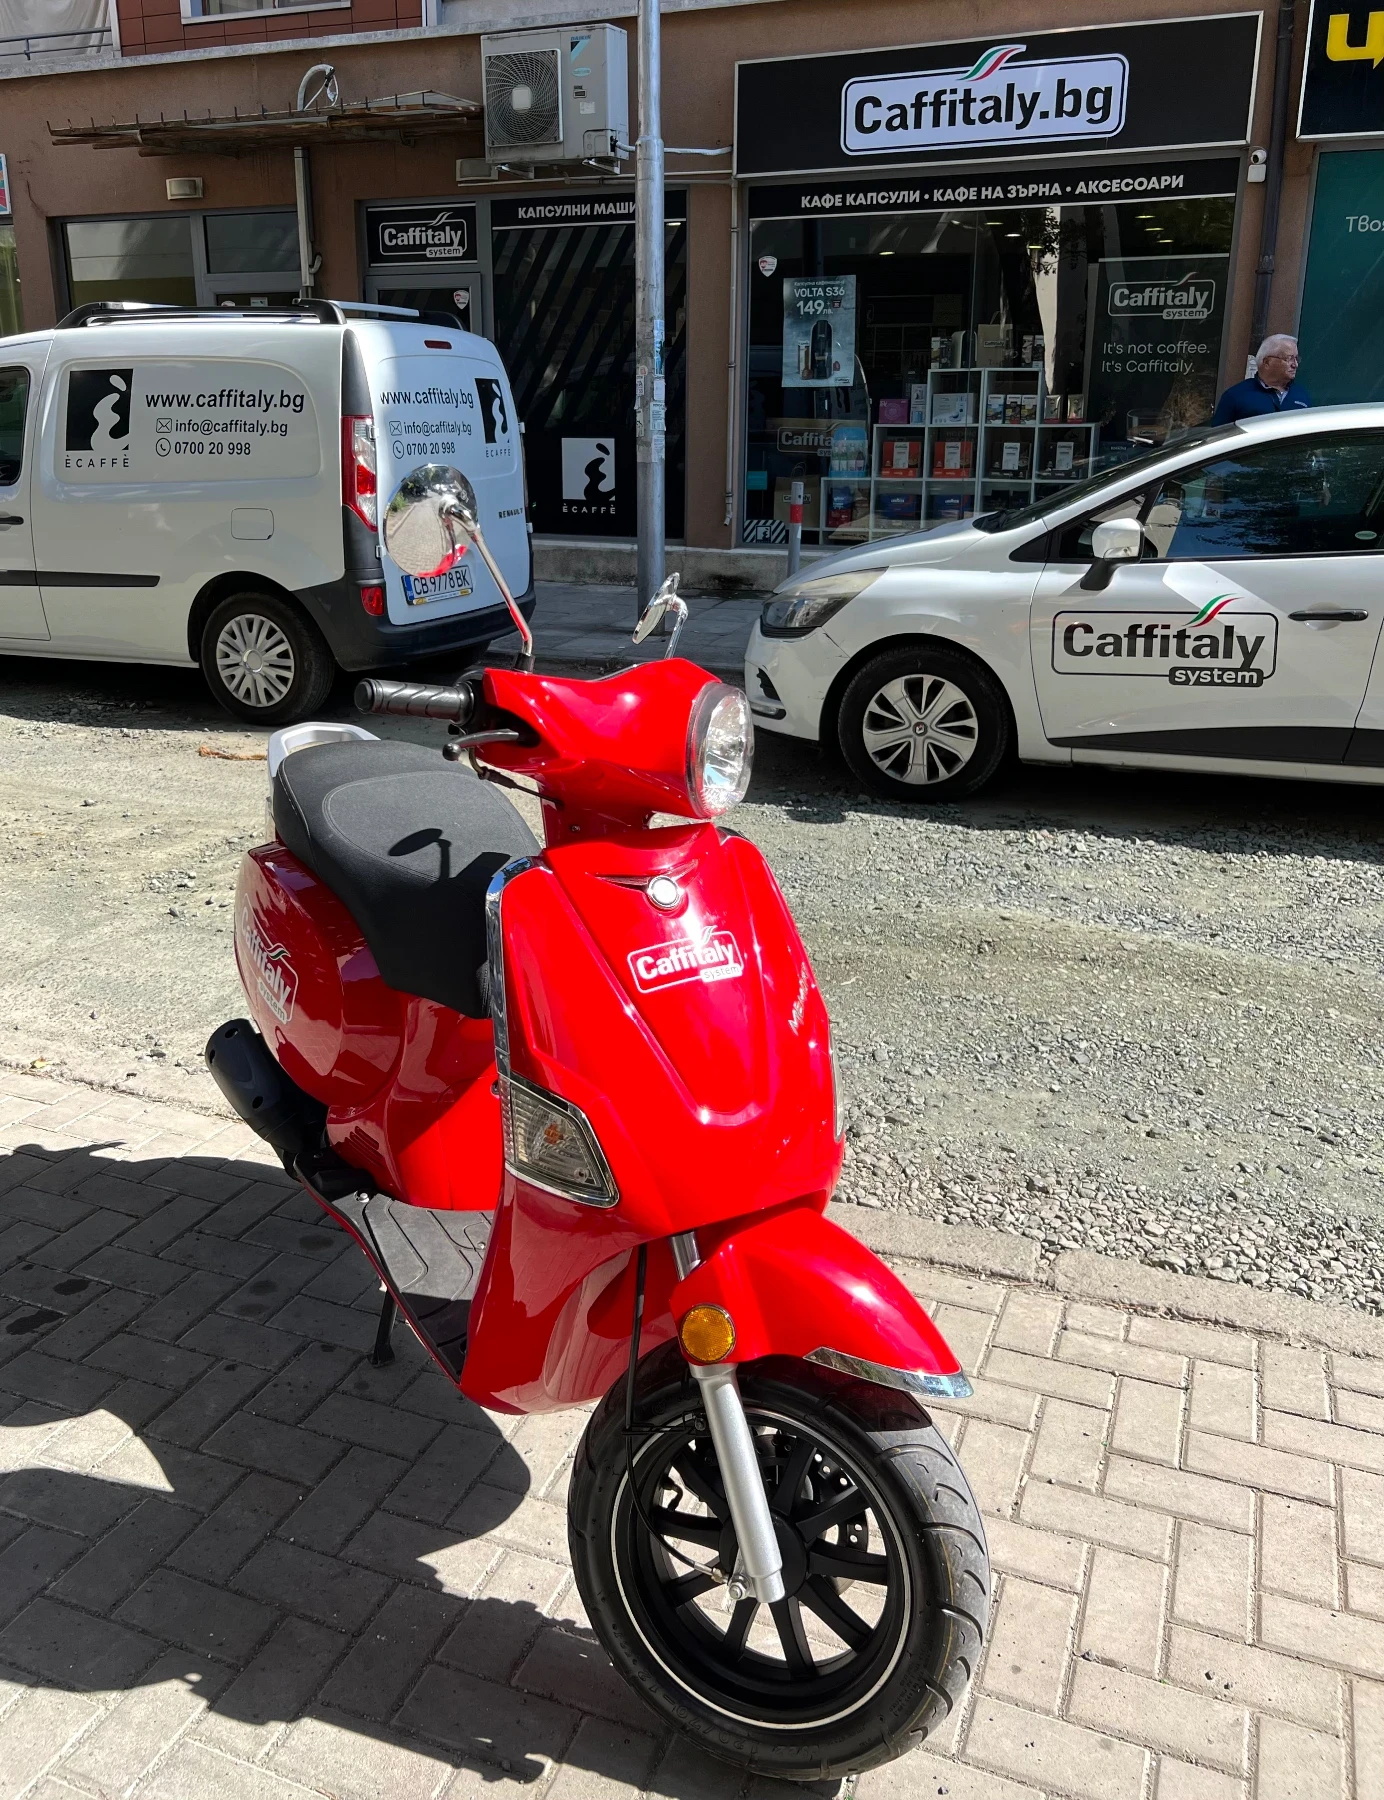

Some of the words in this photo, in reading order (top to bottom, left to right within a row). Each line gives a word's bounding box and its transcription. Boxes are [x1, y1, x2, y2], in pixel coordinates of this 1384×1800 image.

[854, 78, 1112, 134] Caffitaly.bg
[801, 194, 842, 209] КАФЕ
[845, 189, 920, 207] КАПСУЛИ
[933, 187, 978, 203] КАФЕ
[981, 184, 1004, 199] НА
[1007, 182, 1062, 198] ЗЪРНА
[1075, 174, 1185, 195] АКСЕСОАРИ
[518, 203, 591, 219] КАПСУЛНИ
[383, 226, 463, 248] Caffitaly
[428, 246, 461, 257] system
[794, 288, 824, 297] VOLTA
[825, 286, 845, 297] S36
[1113, 286, 1209, 311] Caffitaly
[796, 300, 824, 315] 149
[1165, 309, 1205, 318] system
[1103, 342, 1123, 354] It's
[1127, 342, 1153, 354] not
[1156, 340, 1210, 354] coffee.
[1101, 360, 1122, 372] It's
[1126, 359, 1195, 375] Caffitaly.
[145, 389, 305, 413] www.caffitaly.bg
[380, 388, 474, 408] www.caffitaly.bg
[175, 419, 288, 436] info@caffitaly.bg
[404, 421, 472, 437] info@caffitaly.bg
[174, 441, 204, 455] 0700
[208, 441, 223, 454] 20
[228, 441, 251, 455] 998
[407, 443, 428, 455] 0700
[430, 442, 440, 454] 20
[441, 441, 456, 454] 998
[65, 455, 129, 468] ÈCAFFÈ
[498, 507, 524, 520] RENAULT
[562, 503, 616, 514] ÈCAFFÈ
[1063, 622, 1266, 669] Caffitaly
[1174, 668, 1258, 685] system
[241, 906, 291, 1007] Caffitaly
[636, 940, 736, 980] Caffitaly
[703, 967, 740, 980] system
